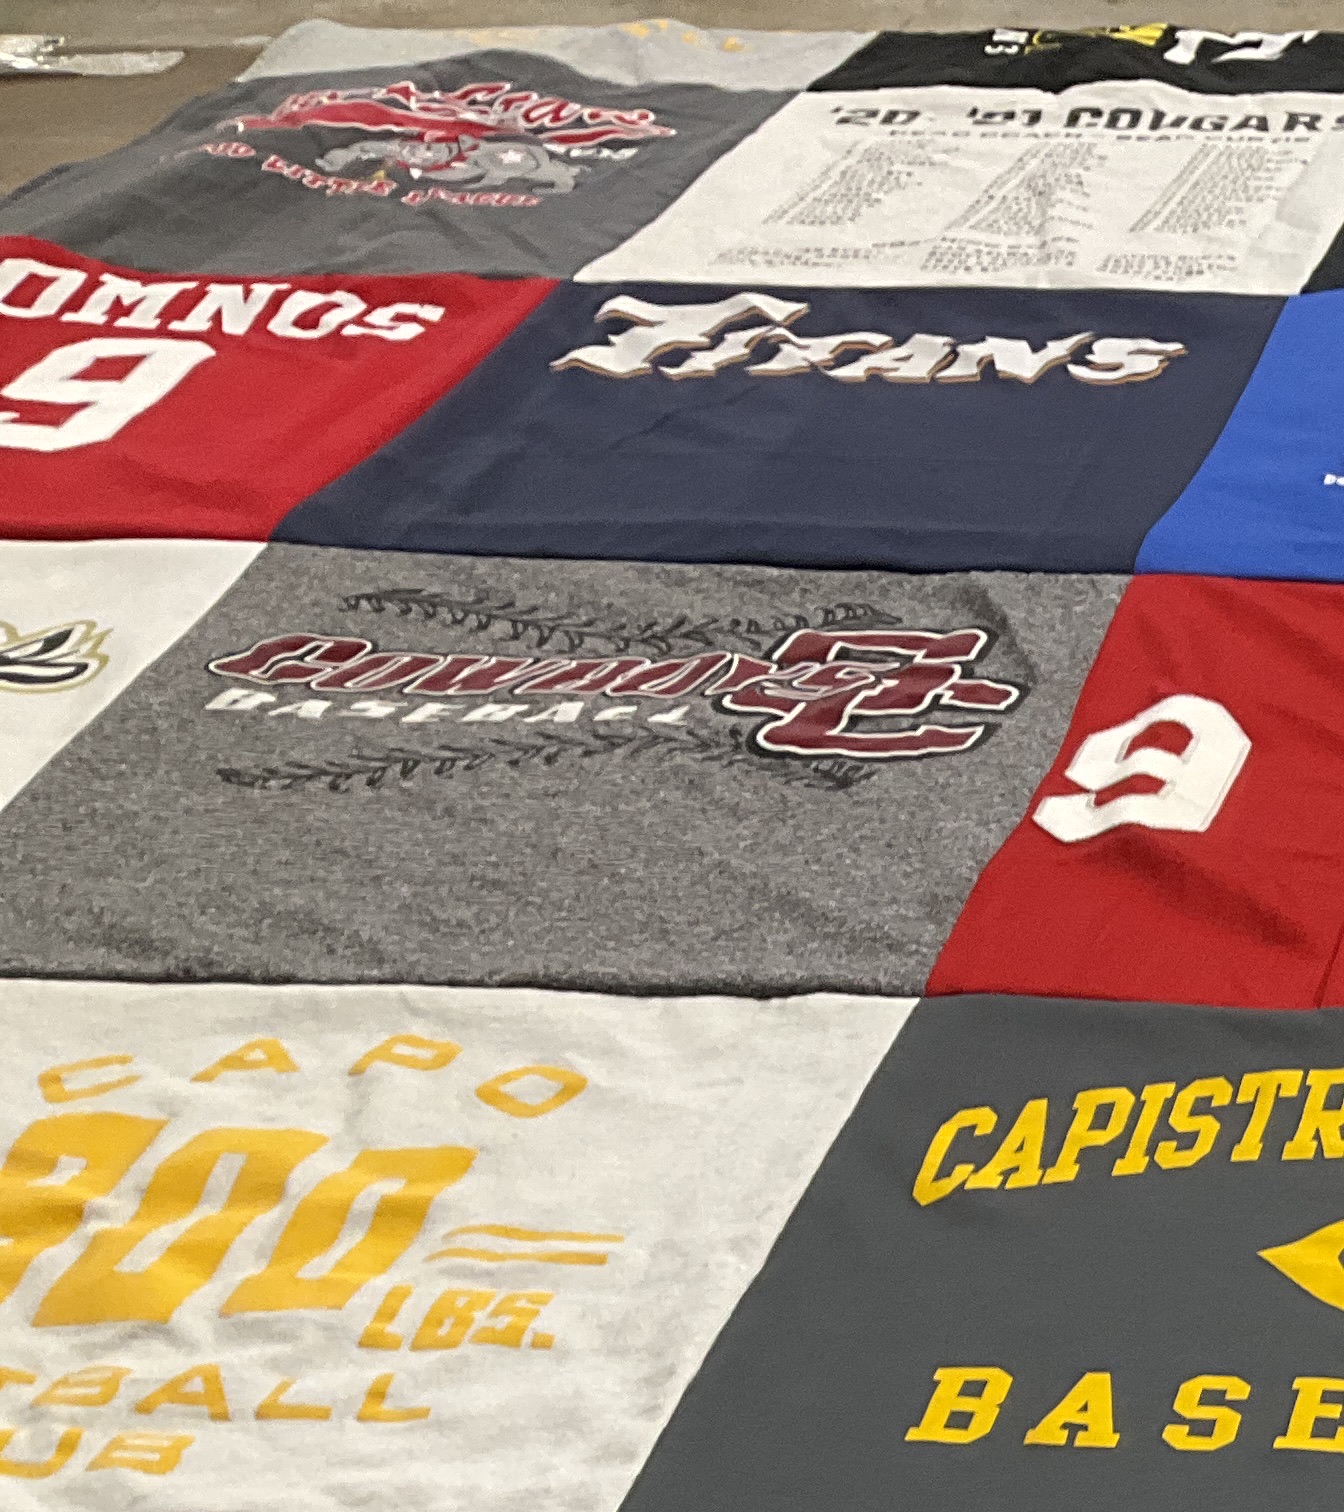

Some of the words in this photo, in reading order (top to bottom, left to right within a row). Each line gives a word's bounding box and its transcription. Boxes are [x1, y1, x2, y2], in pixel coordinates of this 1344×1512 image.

[0, 337, 216, 452] 9
[207, 632, 890, 700] COWBOYS
[205, 688, 693, 724] BASEBALL
[38, 1034, 588, 1118] CAPO
[357, 1285, 555, 1352] LBS.
[0, 1363, 432, 1422] BALL
